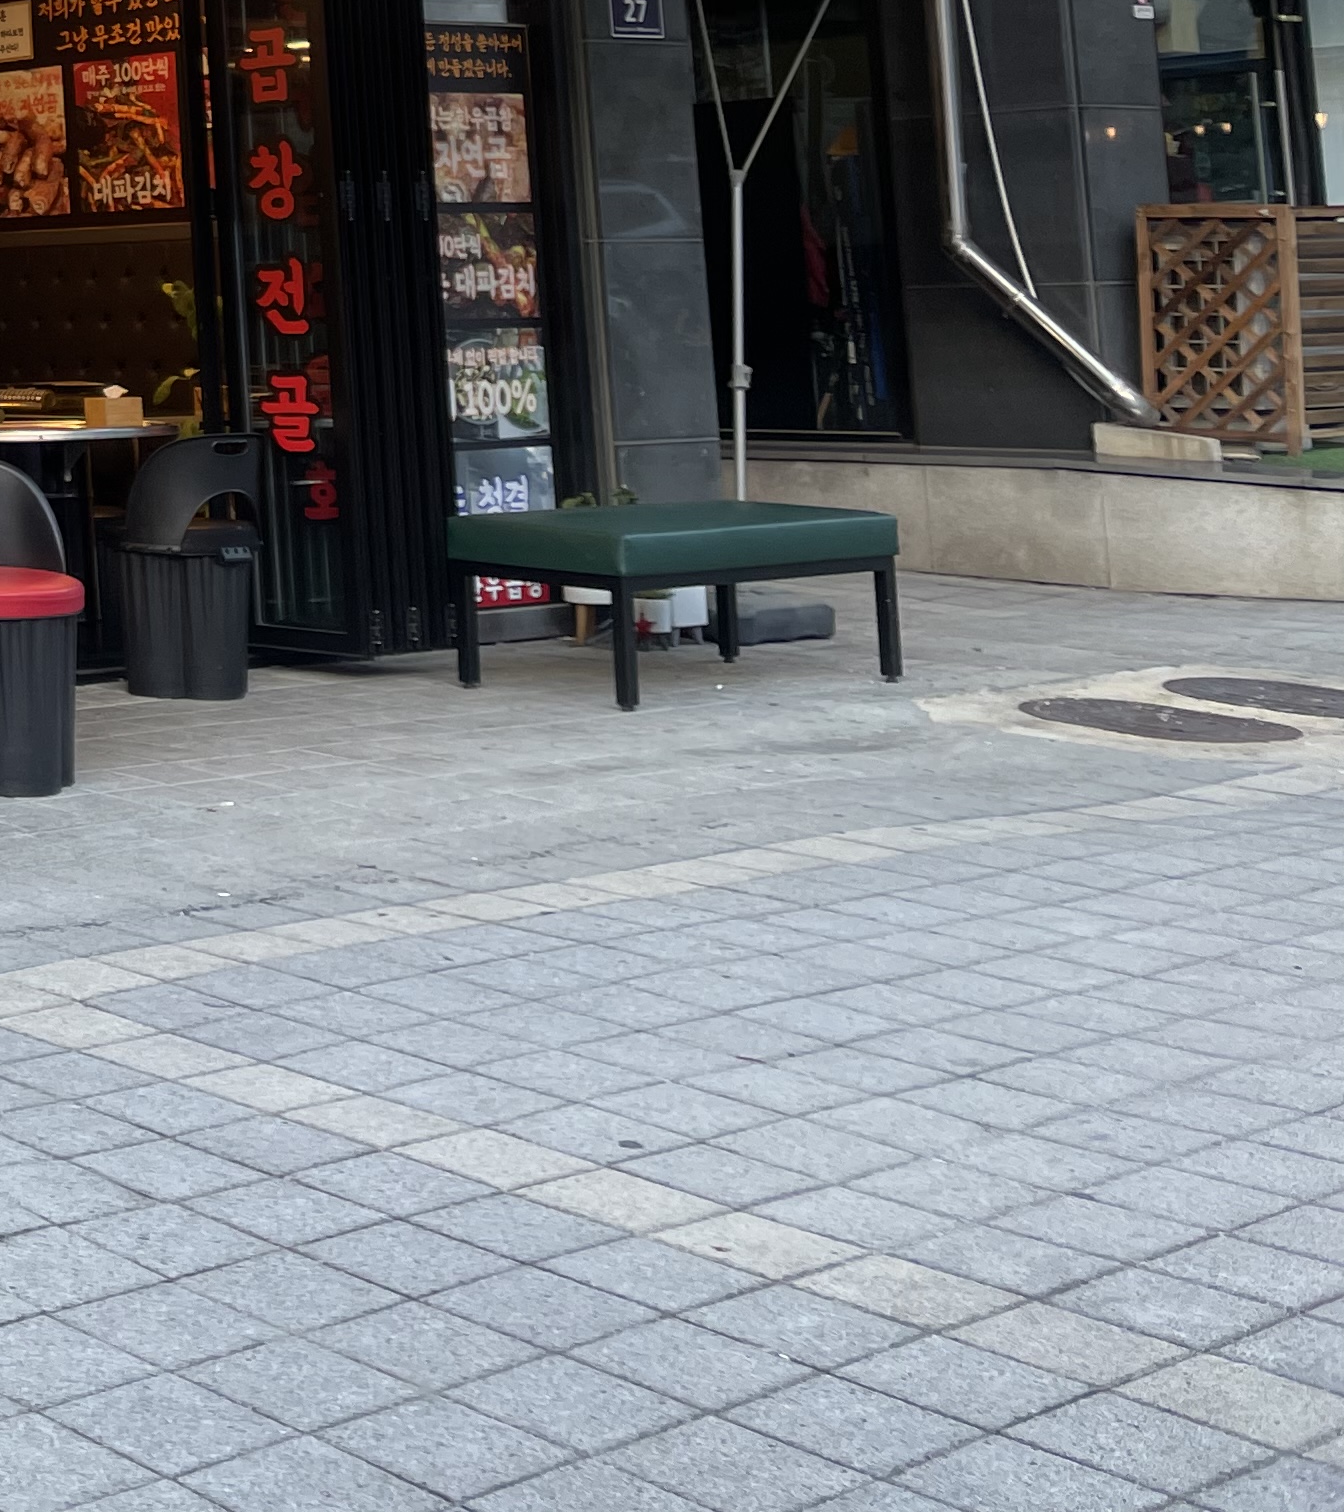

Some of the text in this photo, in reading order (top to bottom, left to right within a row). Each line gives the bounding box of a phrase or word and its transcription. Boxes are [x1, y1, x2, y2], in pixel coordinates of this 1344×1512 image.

[55, 27, 87, 53] 그냥
[91, 19, 143, 50] 무조건
[81, 65, 111, 88] 매주
[434, 134, 512, 179] 자연곱
[93, 170, 172, 206] 대파김치
[455, 263, 537, 301] 대파김치
[462, 377, 538, 417] 100%
